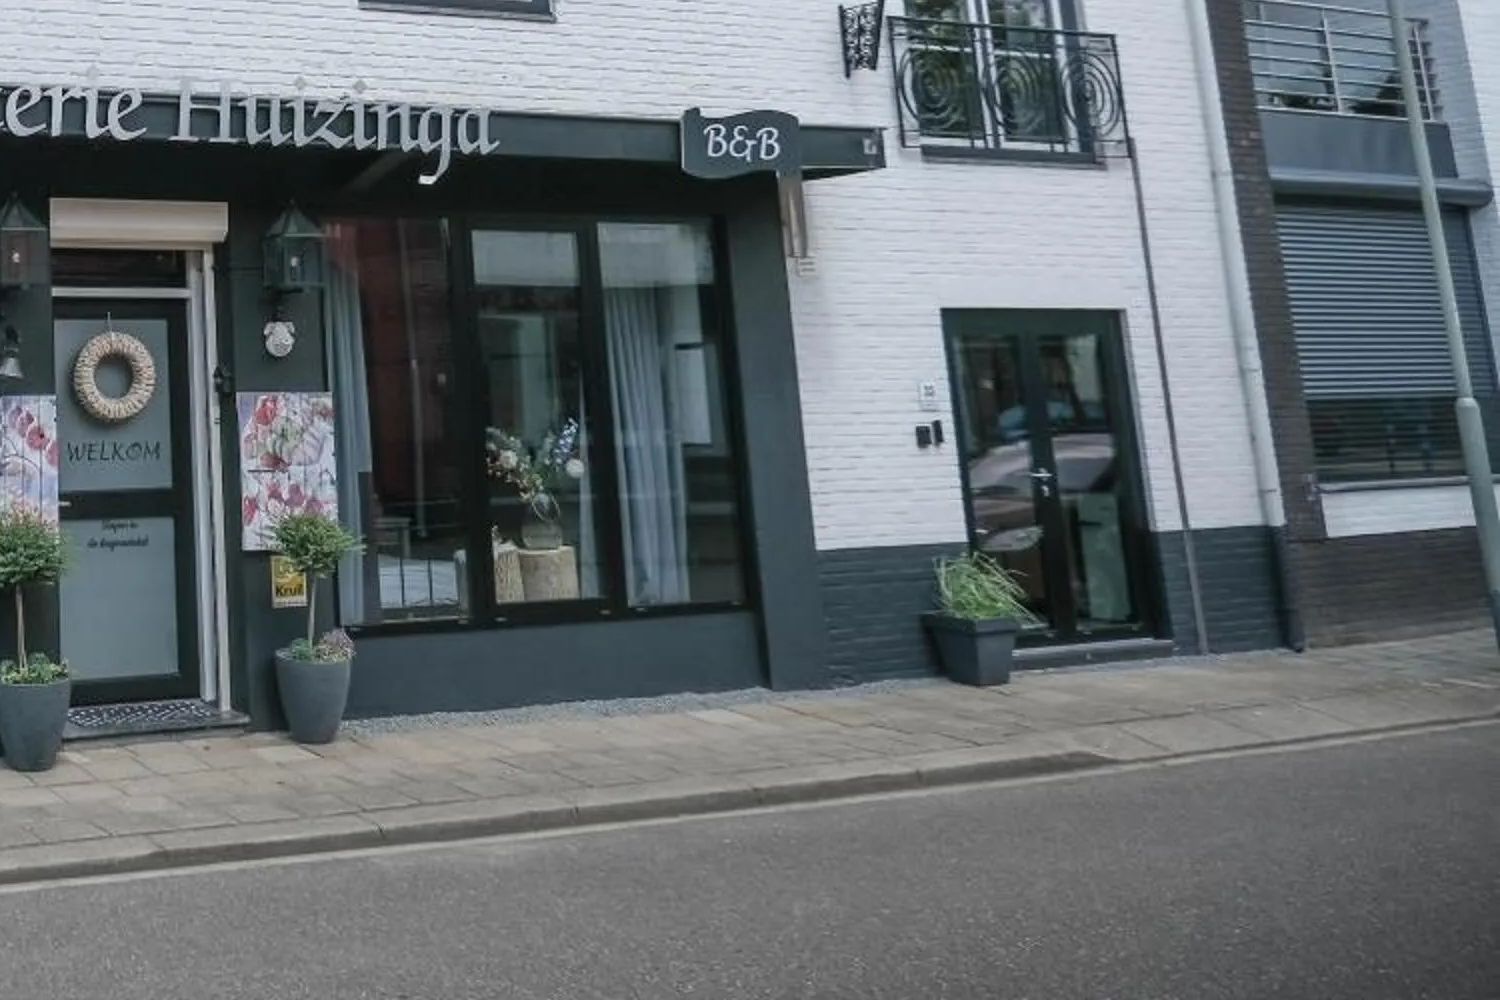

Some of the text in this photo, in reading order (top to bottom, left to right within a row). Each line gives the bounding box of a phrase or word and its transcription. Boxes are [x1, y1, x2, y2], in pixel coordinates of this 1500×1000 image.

[167, 75, 500, 185] Huizinga
[703, 122, 781, 163] B&B
[66, 439, 162, 462] WELKOM
